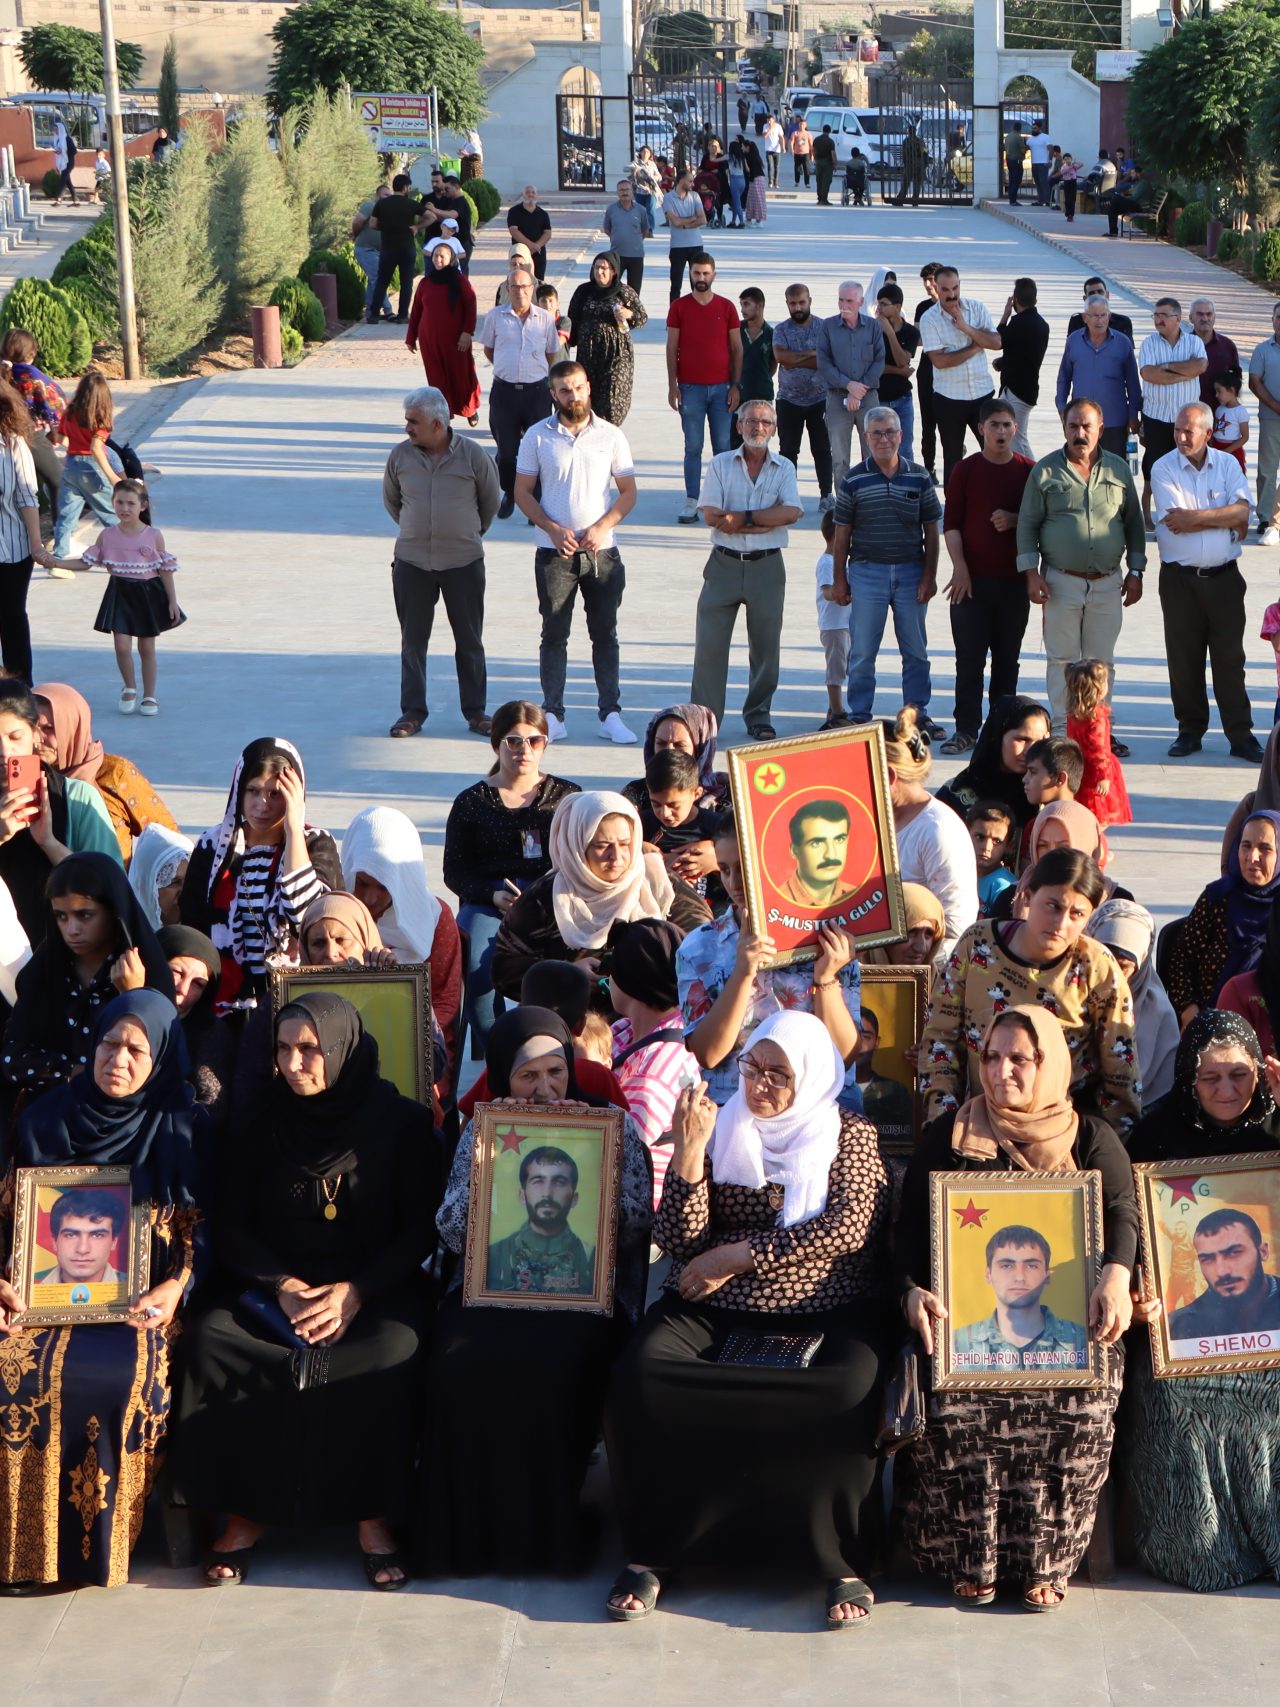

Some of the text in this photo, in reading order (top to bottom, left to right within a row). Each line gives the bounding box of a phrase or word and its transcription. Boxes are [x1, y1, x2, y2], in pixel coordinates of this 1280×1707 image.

[767, 890, 883, 931] Ş-MUSTEA GULO
[1198, 1183, 1210, 1197] G
[1198, 1333, 1272, 1356] Ş.HEMO
[1023, 1350, 1061, 1365] RAMAN
